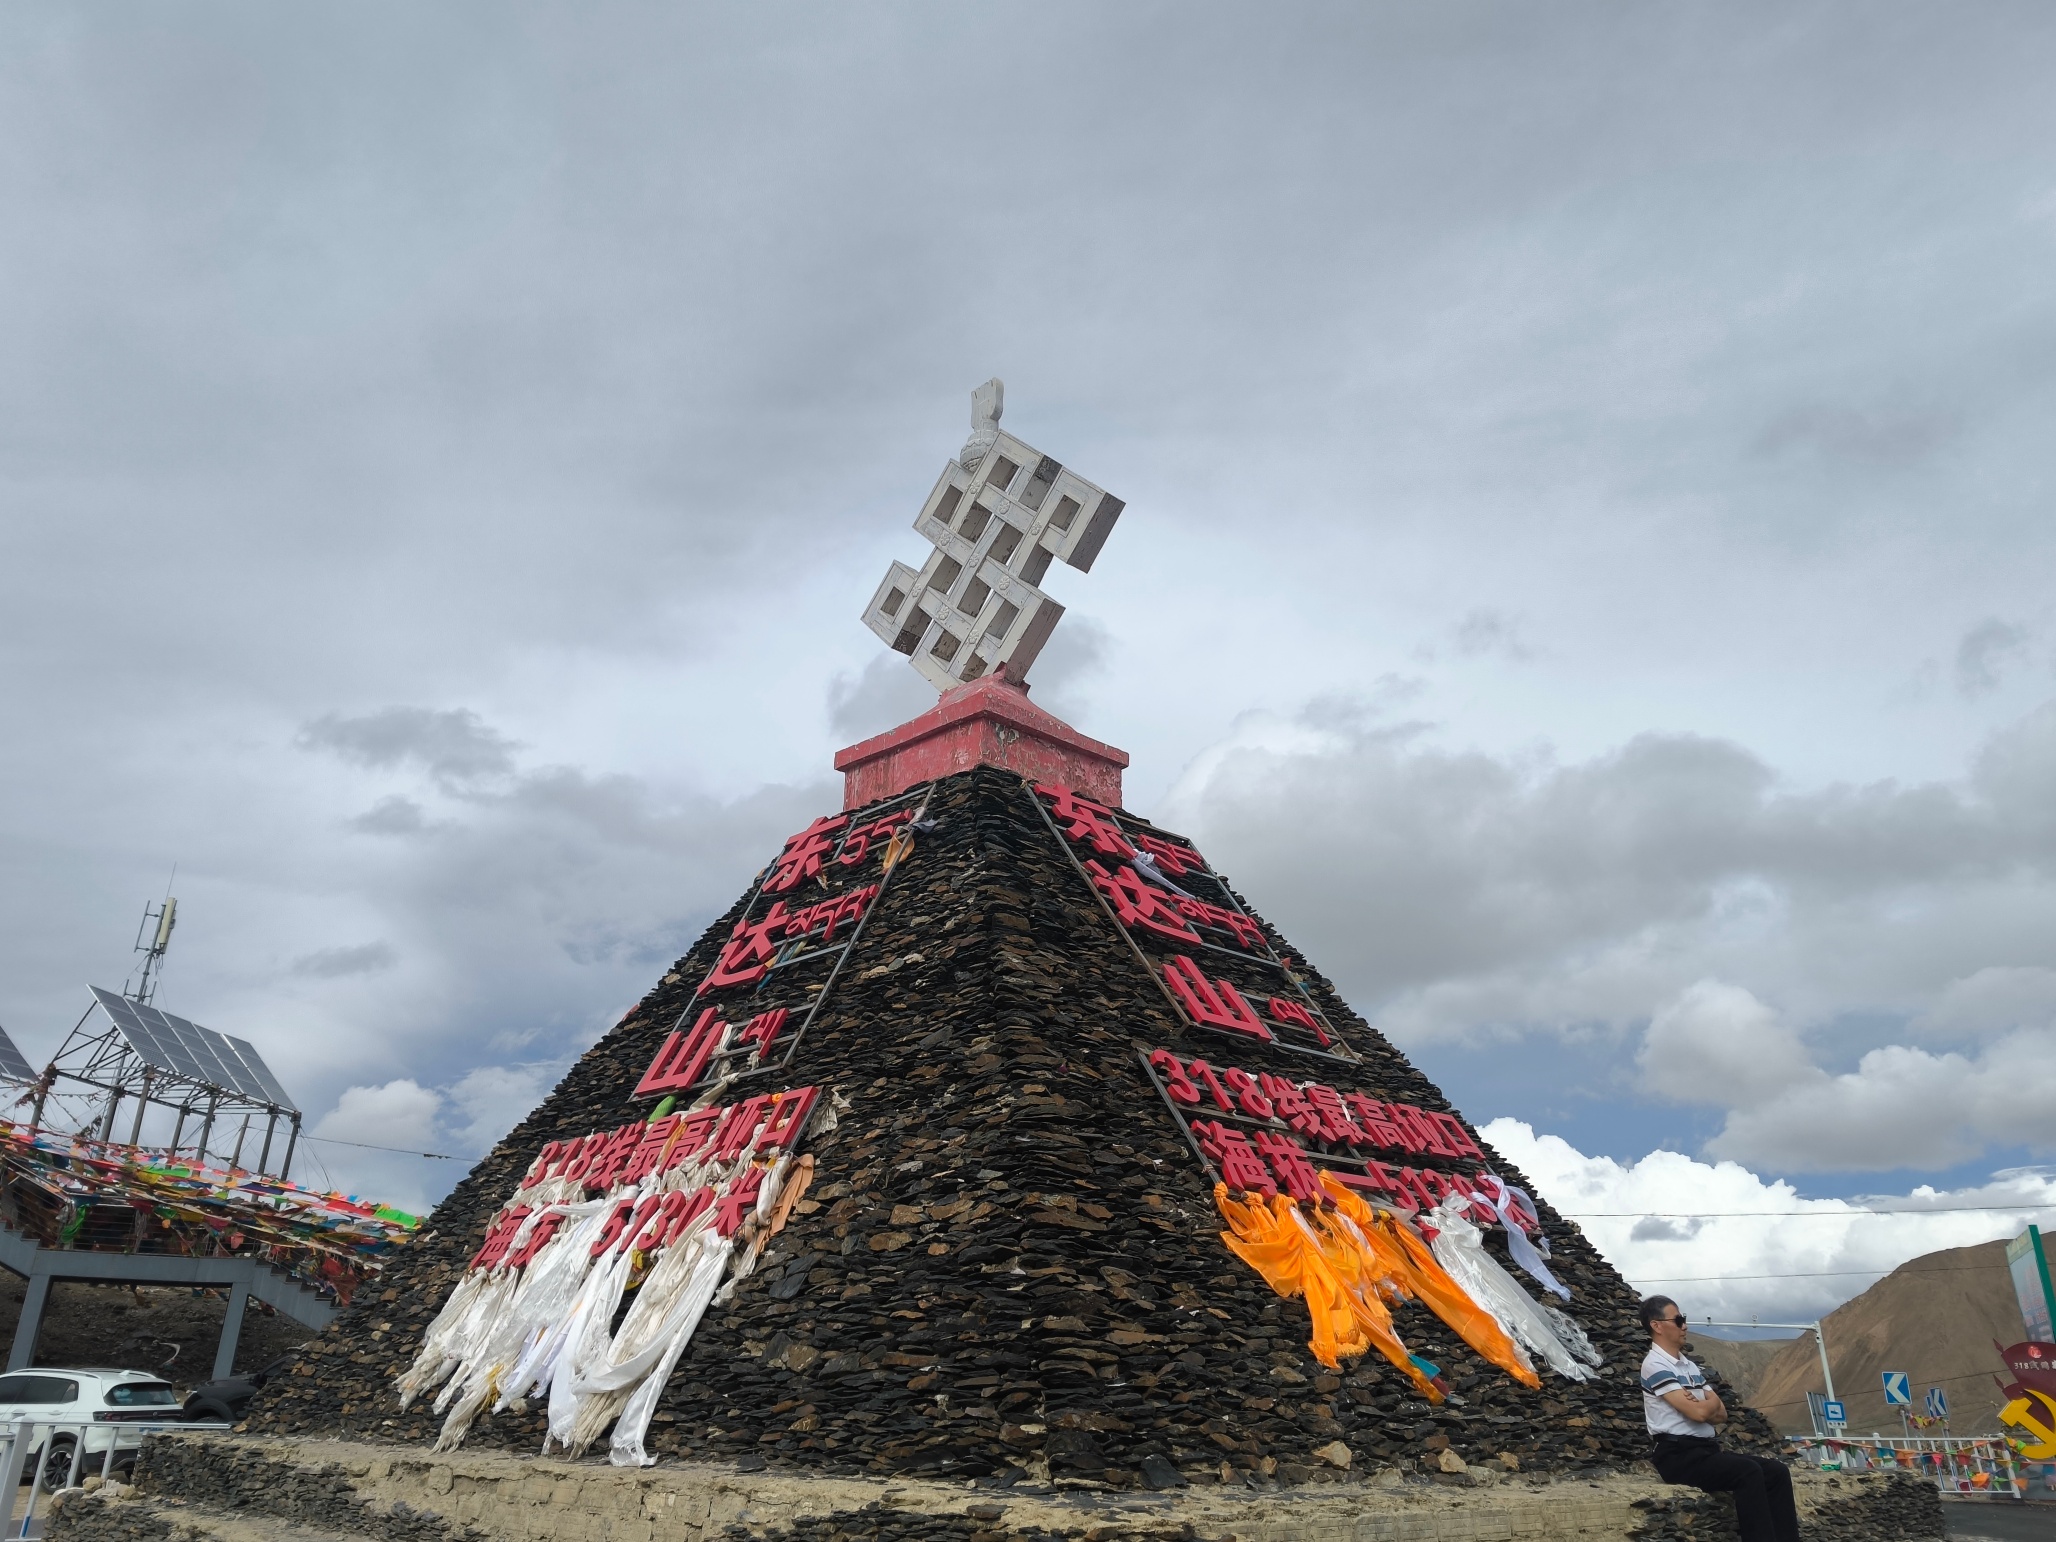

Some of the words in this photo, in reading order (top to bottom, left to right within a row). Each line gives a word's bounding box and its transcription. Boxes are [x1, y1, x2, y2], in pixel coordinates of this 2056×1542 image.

[634, 815, 849, 1097] 东达山
[1033, 783, 1273, 1045] 东达山
[521, 1085, 819, 1192] 318线最高垭口
[1149, 1048, 1487, 1163] 318线最高垭口
